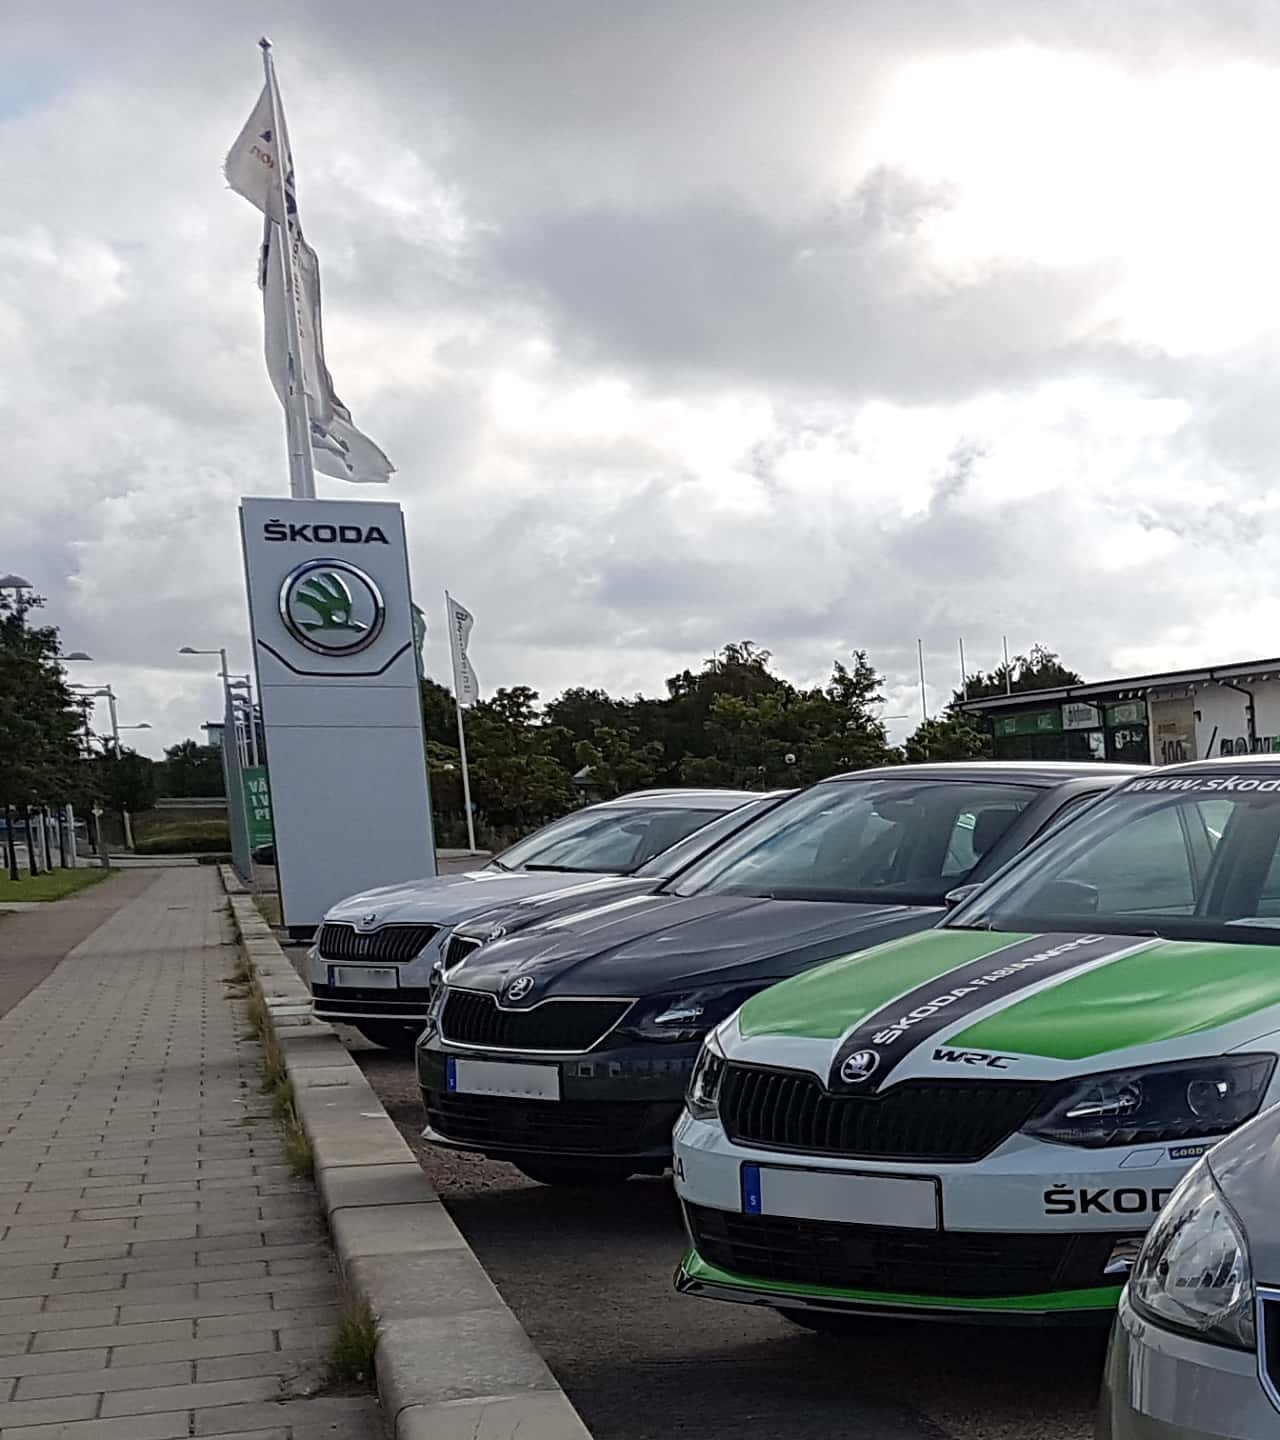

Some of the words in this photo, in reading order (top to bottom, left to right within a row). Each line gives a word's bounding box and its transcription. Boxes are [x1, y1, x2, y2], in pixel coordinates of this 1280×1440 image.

[263, 518, 390, 545] ŠKODA
[872, 985, 979, 1045] ŠKODA
[969, 961, 1035, 986] FABIA
[932, 1049, 1020, 1069] WRC
[749, 1195, 757, 1206] S
